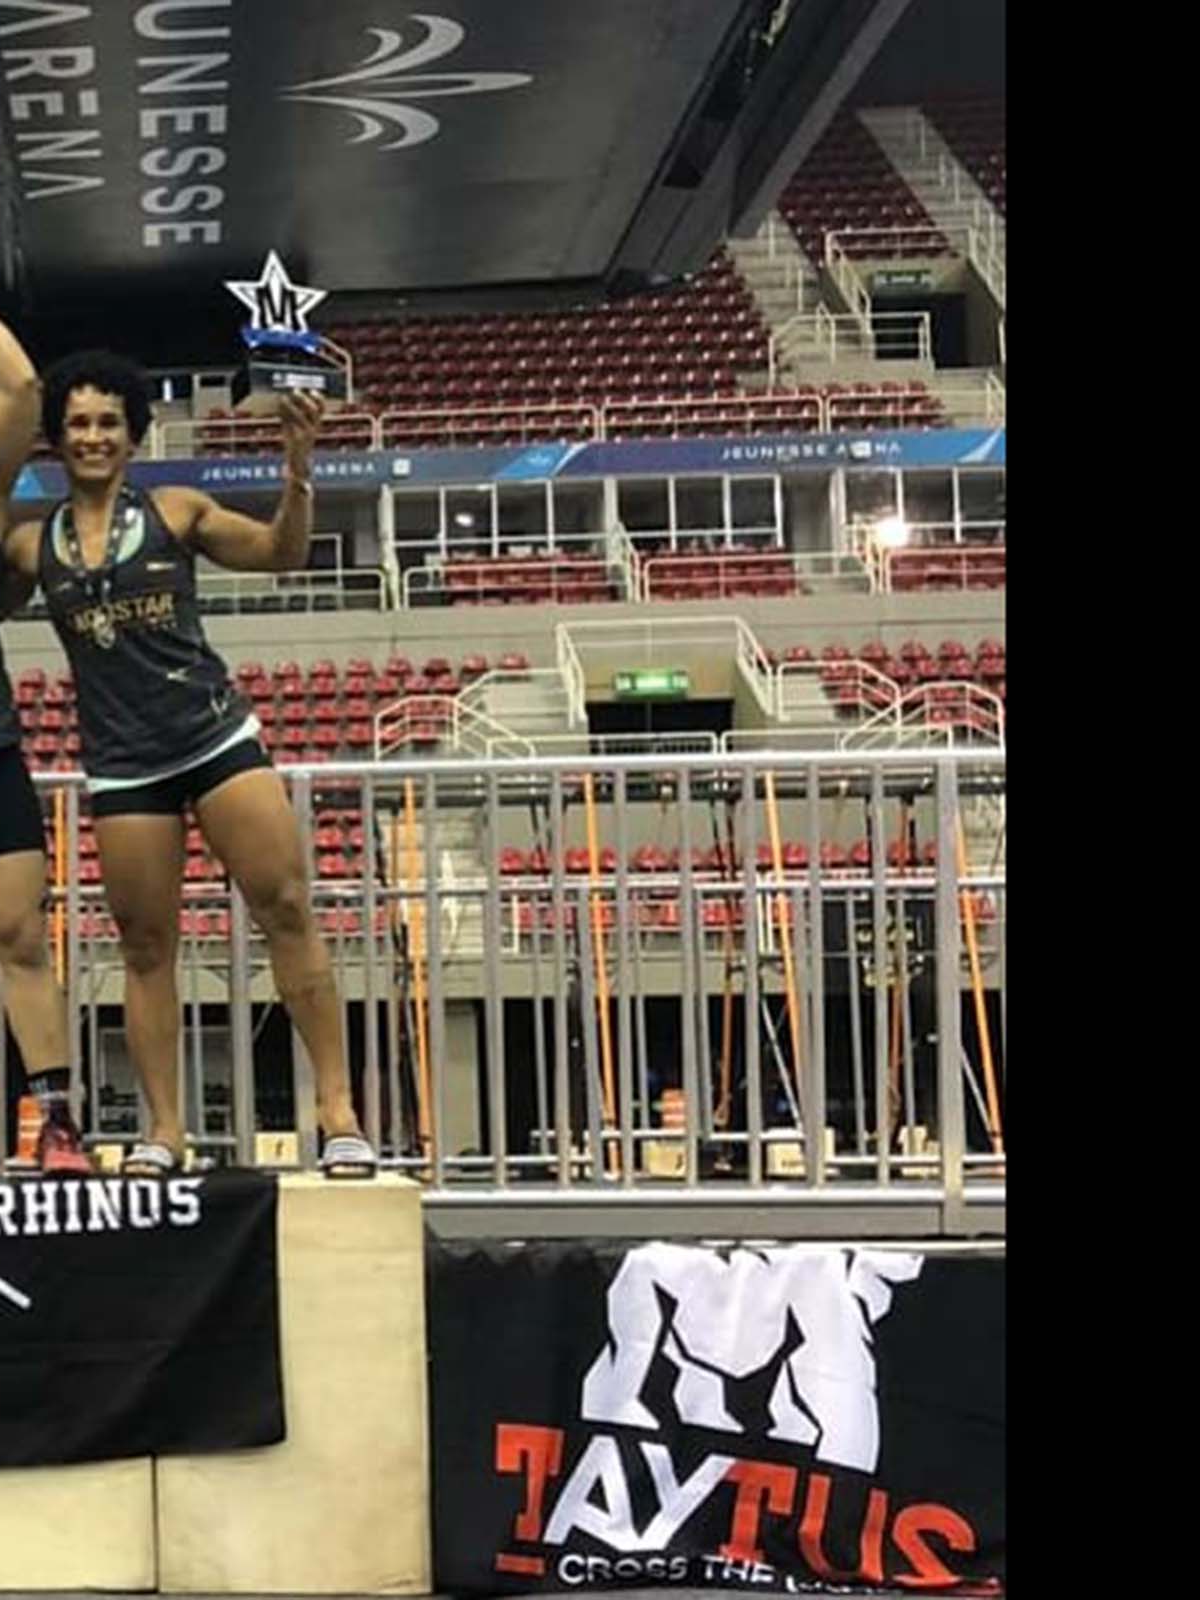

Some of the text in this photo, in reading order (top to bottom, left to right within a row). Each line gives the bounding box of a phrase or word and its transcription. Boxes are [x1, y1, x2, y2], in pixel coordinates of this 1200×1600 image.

[313, 462, 376, 476] ARENA
[494, 1422, 978, 1589] TAYTUS
[557, 1553, 689, 1585] CROSS
